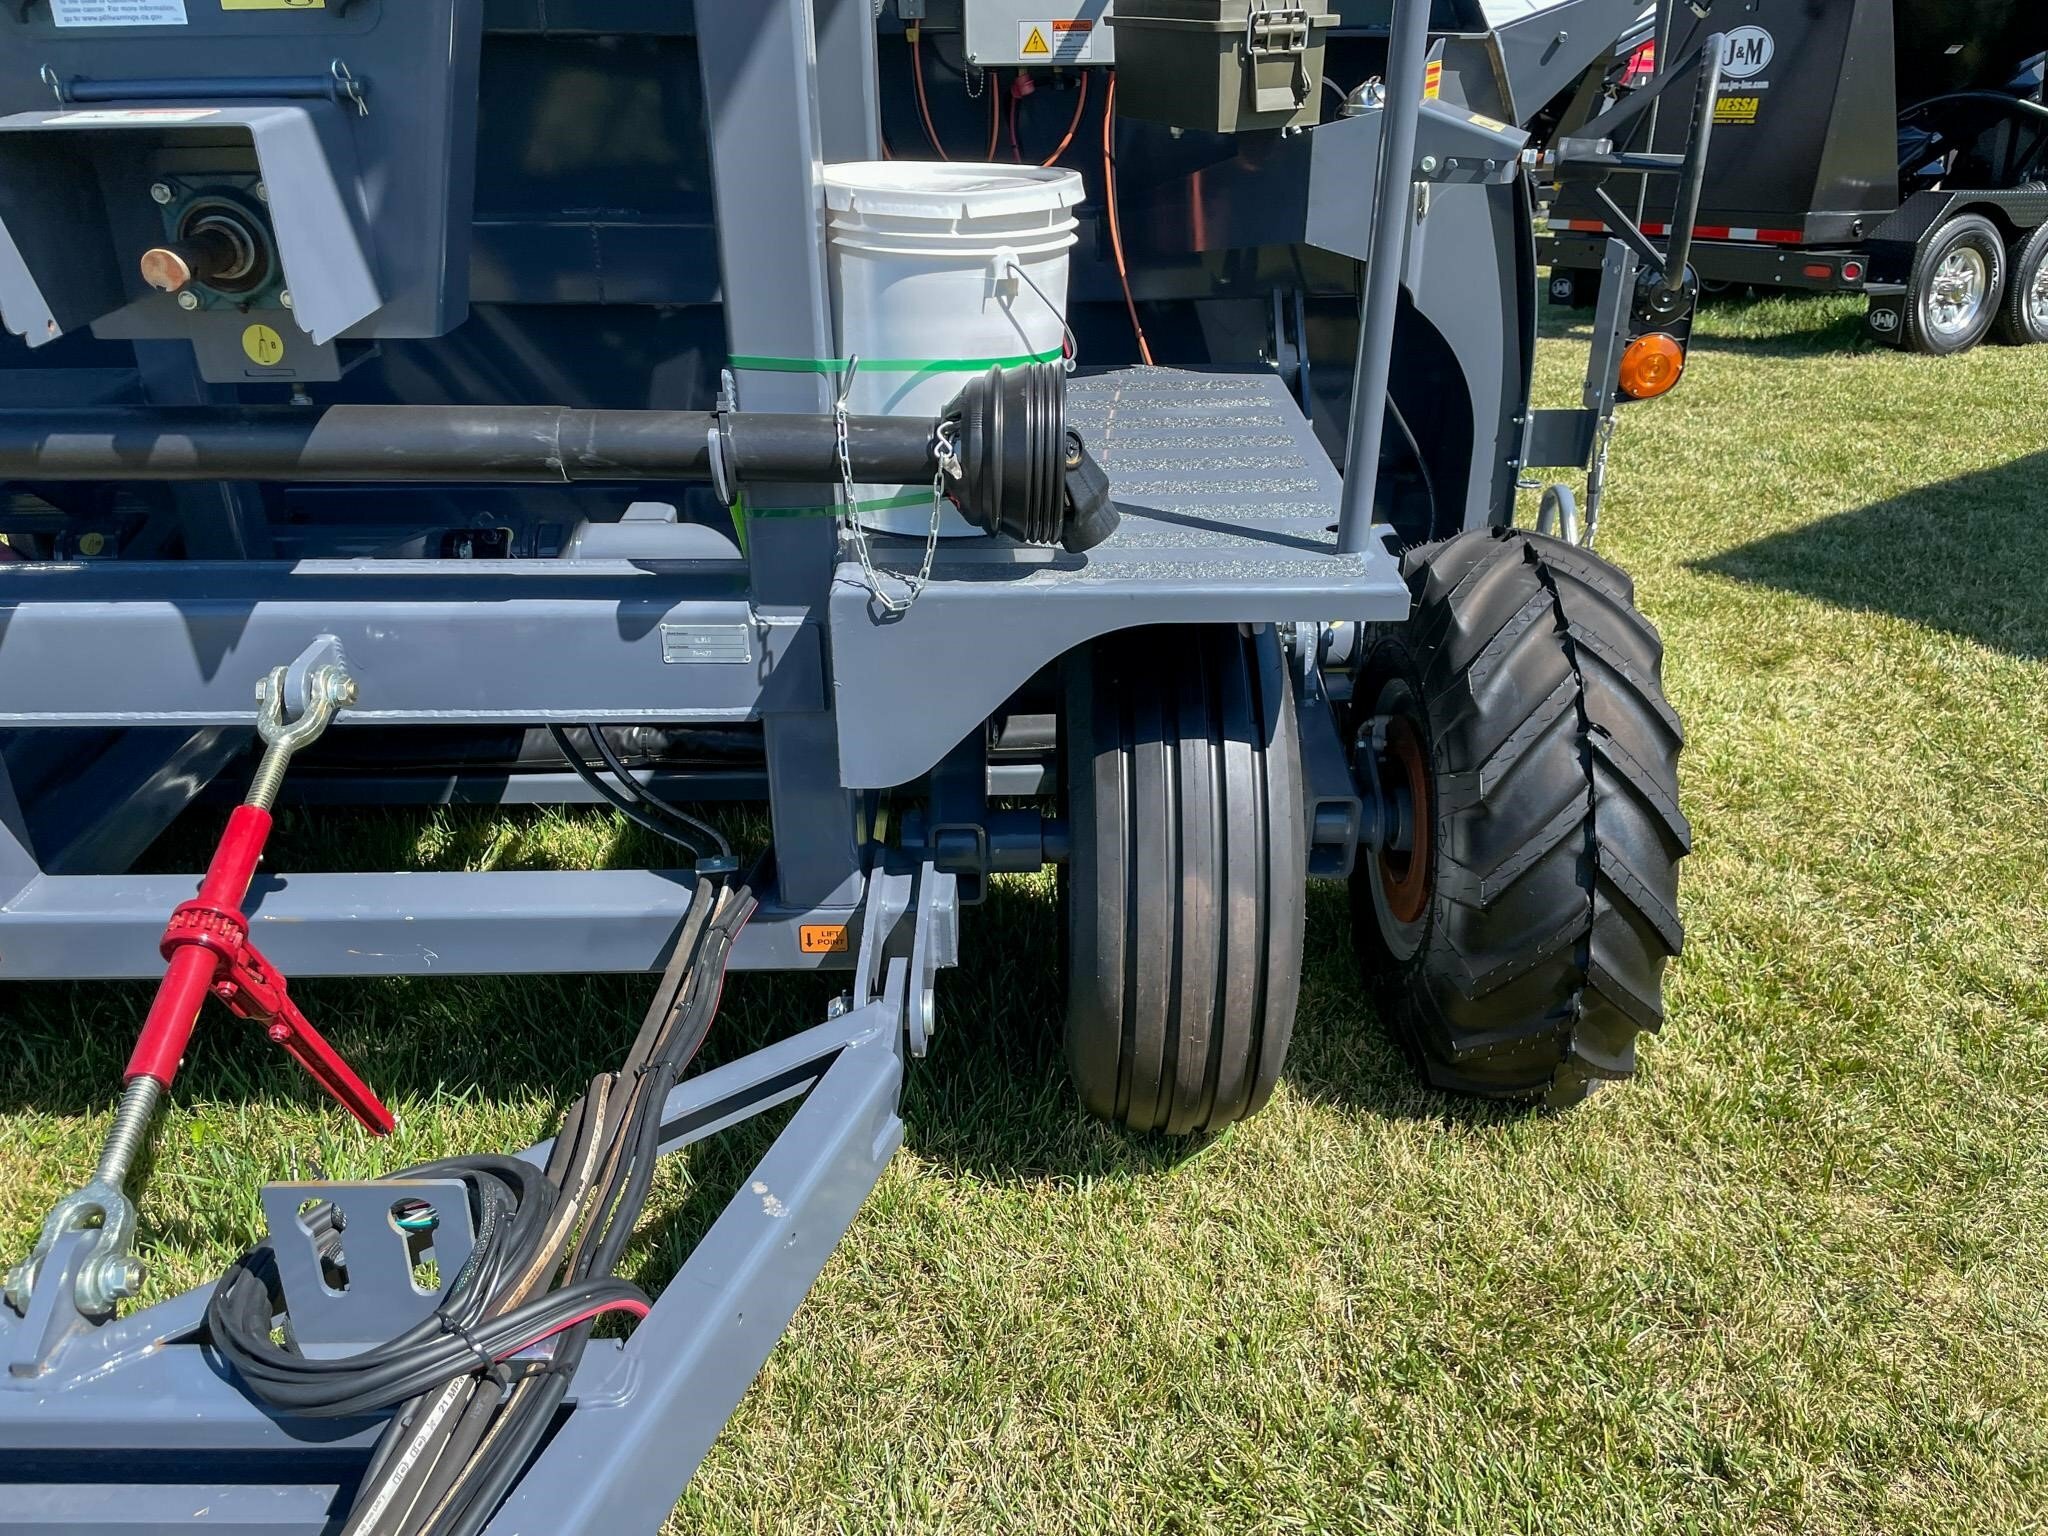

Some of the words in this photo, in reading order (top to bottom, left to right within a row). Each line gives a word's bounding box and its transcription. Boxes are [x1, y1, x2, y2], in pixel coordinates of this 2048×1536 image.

[1722, 38, 1766, 66] J&M
[1715, 98, 1759, 110] NESSA
[817, 938, 845, 946] POINT
[438, 1400, 450, 1414] 21
[448, 1376, 465, 1399] MPa
